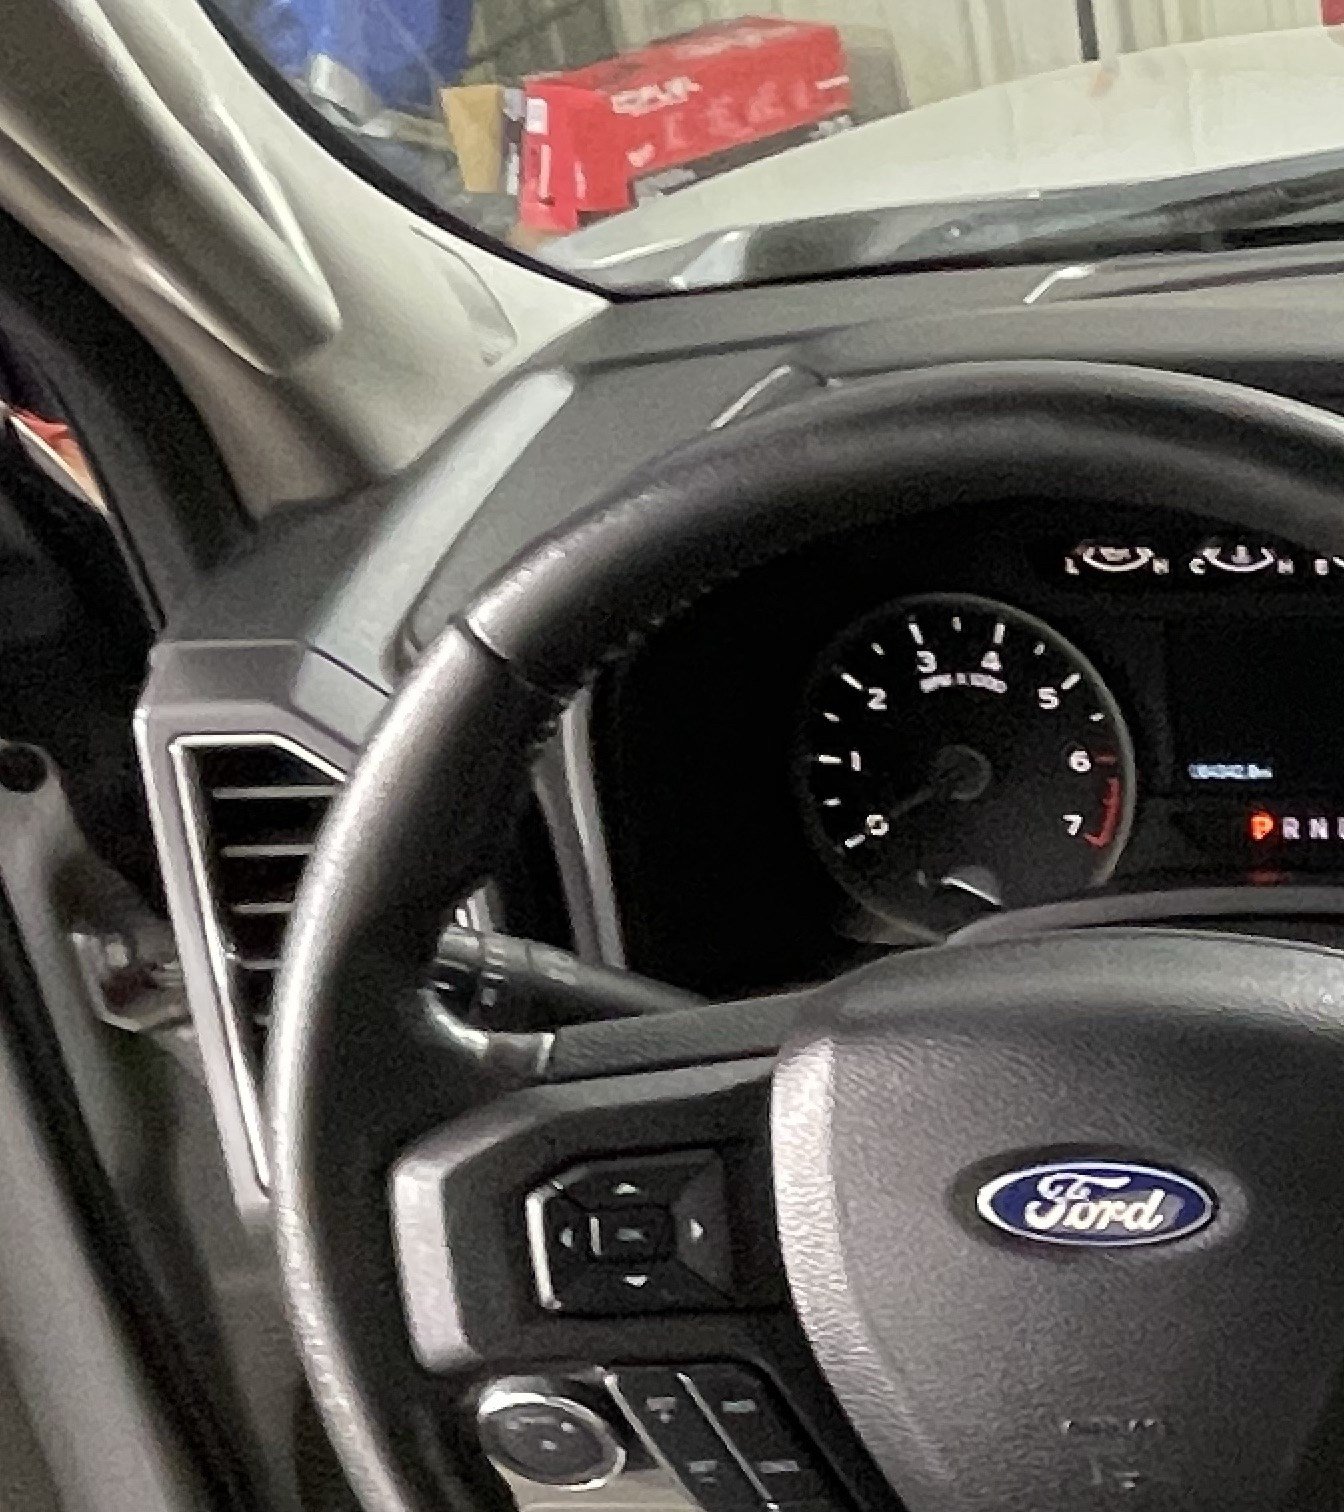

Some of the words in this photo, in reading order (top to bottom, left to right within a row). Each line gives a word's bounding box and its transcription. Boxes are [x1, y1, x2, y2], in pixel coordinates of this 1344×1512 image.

[916, 650, 937, 673] 3
[980, 650, 1002, 672] 4
[866, 686, 888, 711] 2
[1037, 686, 1060, 710] 5
[849, 750, 862, 772] 1
[1068, 750, 1092, 773] 6
[865, 814, 889, 836] 0
[1062, 813, 1084, 836] 7
[1251, 812, 1274, 840] P
[1282, 816, 1301, 839] R
[1309, 816, 1329, 839] N
[1024, 1172, 1166, 1231] Ford
